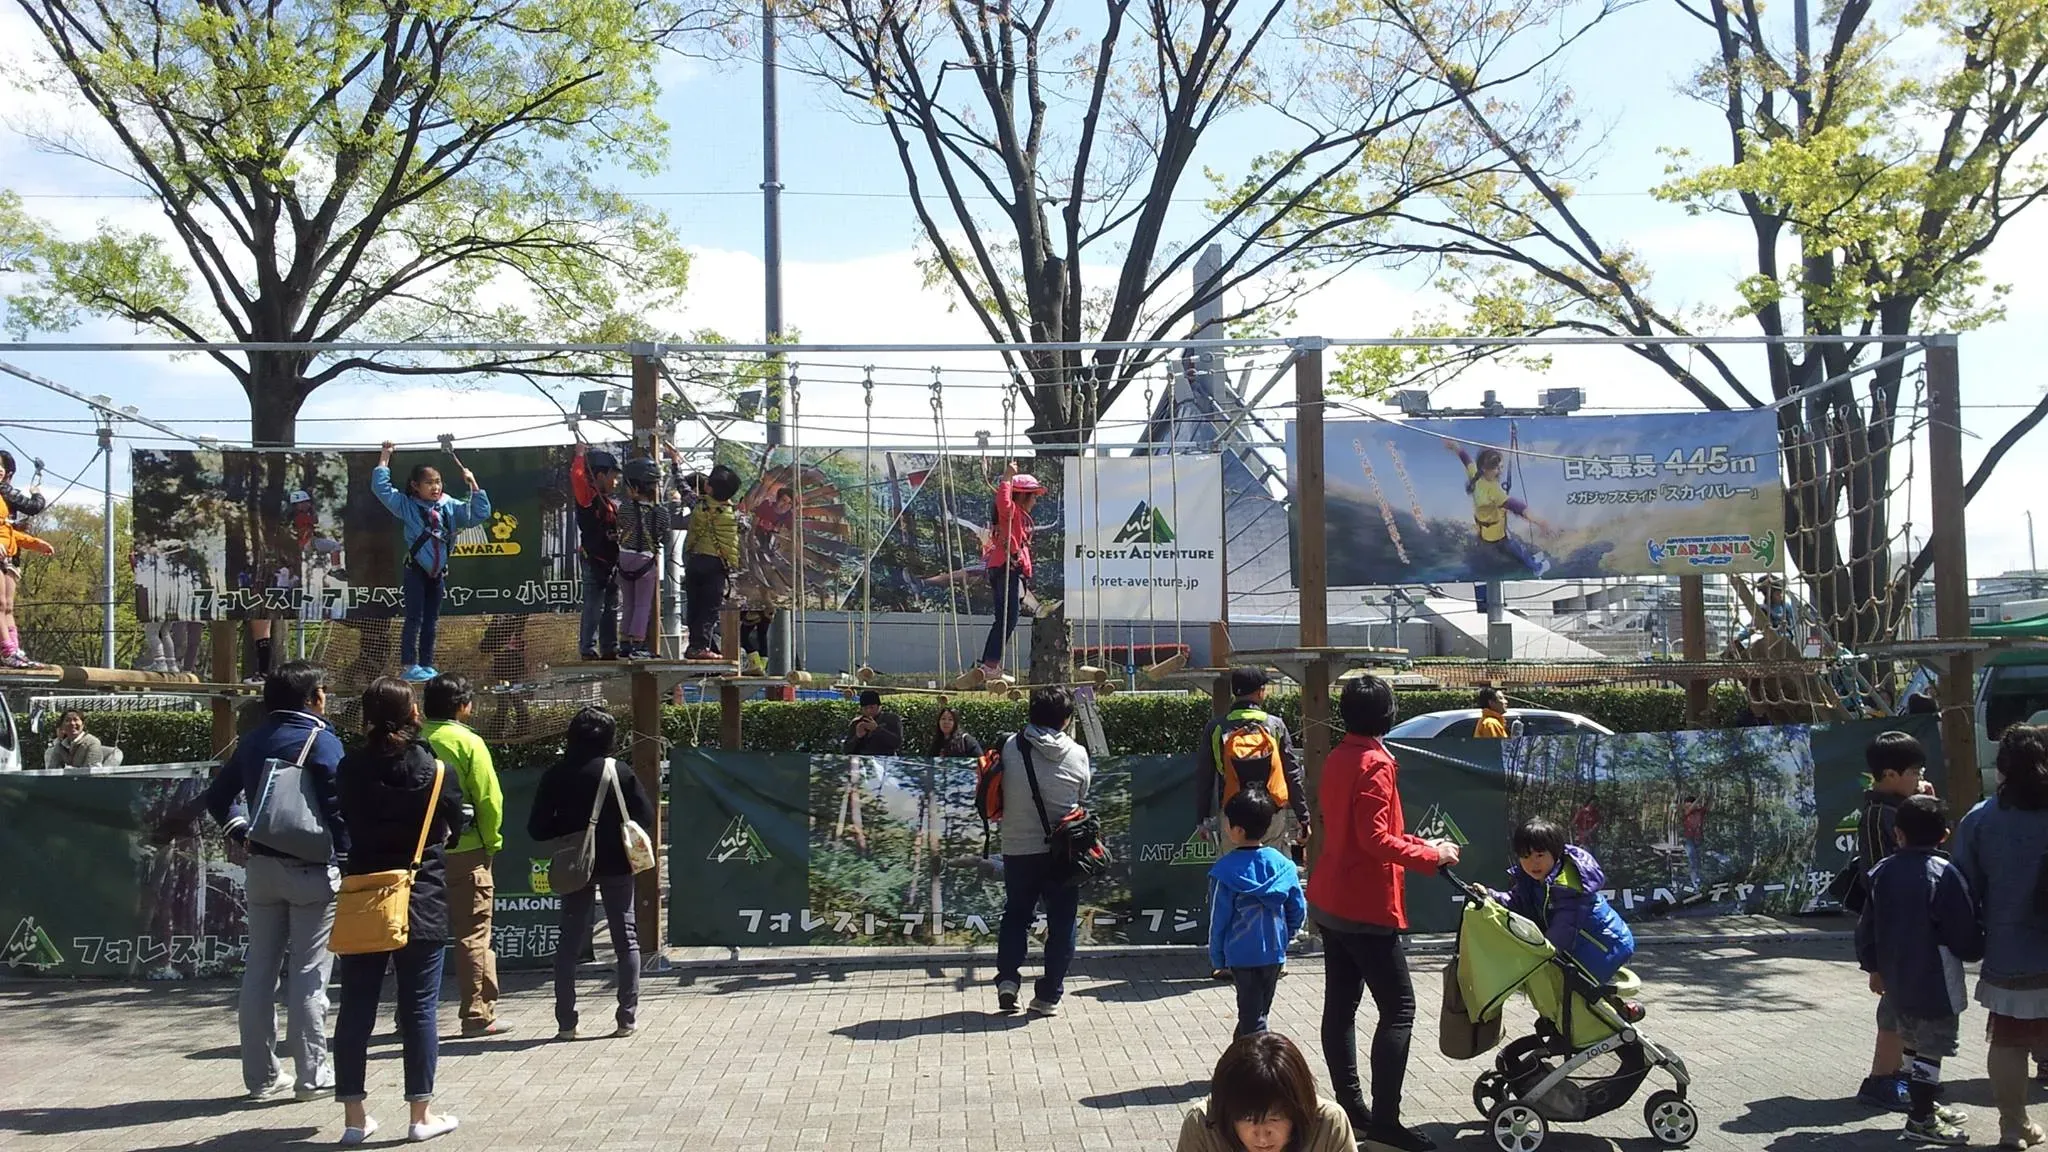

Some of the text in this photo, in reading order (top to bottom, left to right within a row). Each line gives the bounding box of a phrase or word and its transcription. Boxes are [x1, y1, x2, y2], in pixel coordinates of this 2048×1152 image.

[1563, 446, 1757, 481] 日本最長 445m
[1075, 545, 1215, 560] FOREST ADVENTURE
[1666, 542, 1752, 556] TARZANIA
[1092, 575, 1199, 590] foret-aventure.jp
[493, 897, 562, 911] HAKONE
